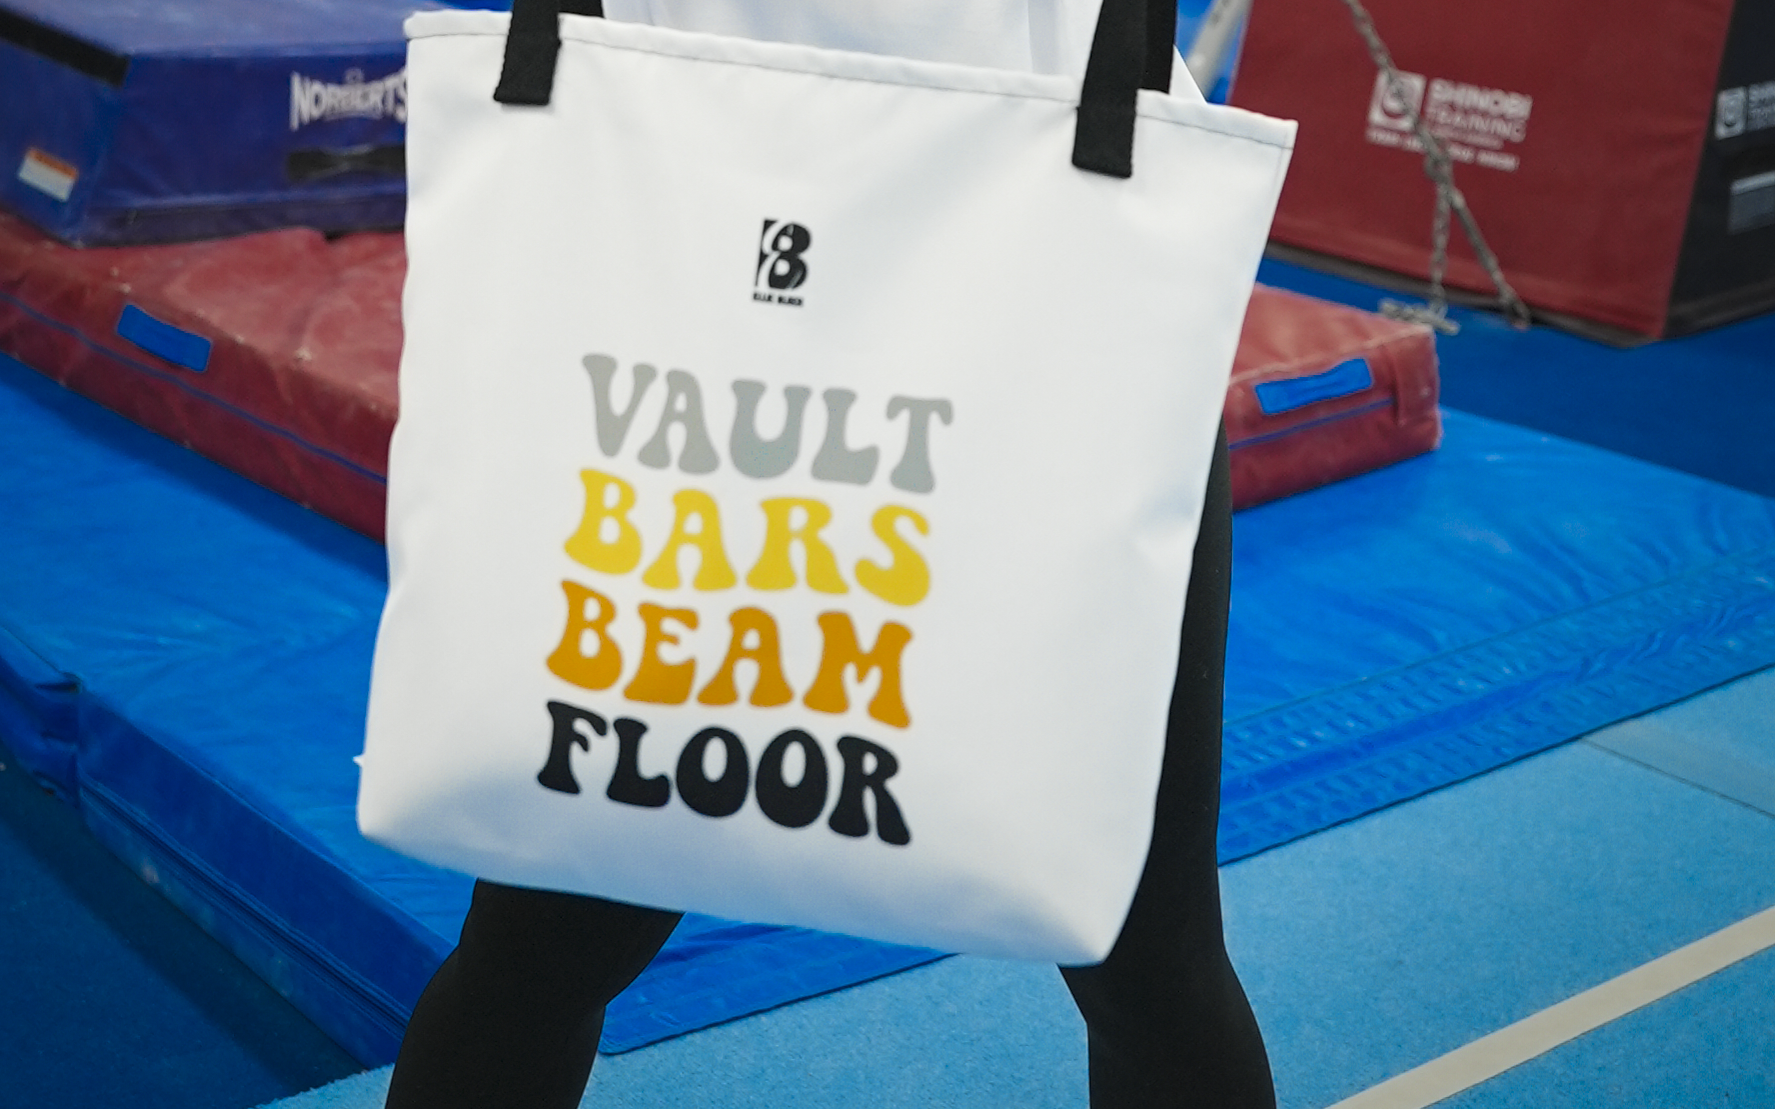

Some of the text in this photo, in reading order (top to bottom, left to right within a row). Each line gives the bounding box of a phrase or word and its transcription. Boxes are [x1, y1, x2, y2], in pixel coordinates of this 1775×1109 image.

[581, 352, 954, 494] VAULT
[562, 467, 932, 608] BARS
[545, 579, 914, 730] BEAM
[536, 700, 911, 847] FLOOR
